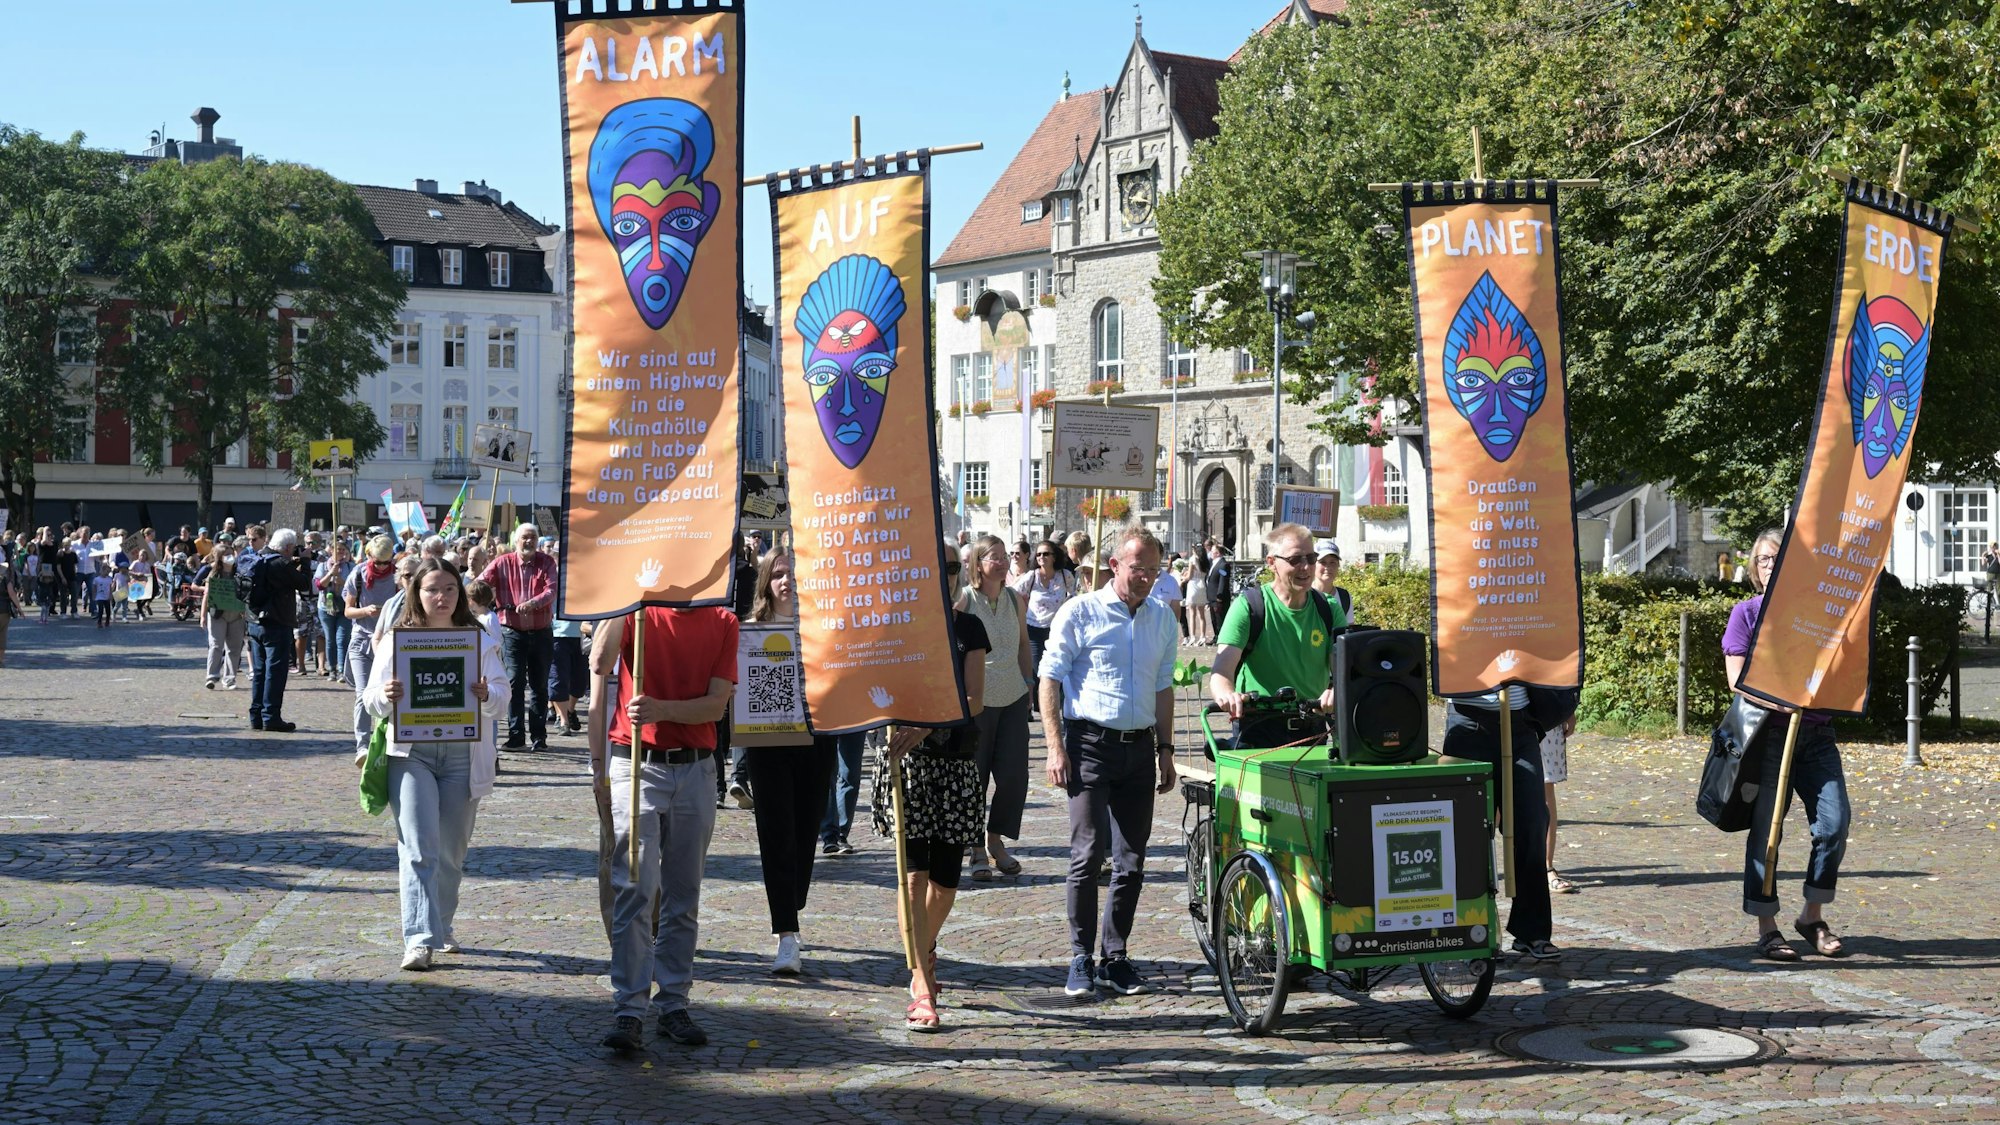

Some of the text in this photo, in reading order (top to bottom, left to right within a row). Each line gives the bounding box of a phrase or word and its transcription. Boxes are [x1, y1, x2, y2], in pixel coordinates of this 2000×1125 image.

[576, 32, 725, 83] ALARM
[809, 195, 892, 253] AUF
[1422, 219, 1543, 258] PLANET
[1865, 224, 1933, 283] ERDE
[598, 348, 716, 368] Wir sind auf
[586, 371, 726, 391] einem Highway
[632, 395, 684, 412] in die
[609, 418, 706, 436] Klimahölle
[609, 440, 706, 458] und haben
[601, 460, 714, 481] den Fuß auf
[587, 484, 723, 503] dem Gaspedal.
[1468, 478, 1536, 494] Draußen
[814, 486, 896, 507] Geschätzt
[1478, 498, 1529, 512] brennt
[1856, 492, 1874, 509] Wir
[803, 510, 876, 528] verlieren
[885, 505, 910, 520] wir
[1470, 515, 1540, 531] die Welt,
[1839, 511, 1882, 532] müssen
[816, 529, 899, 548] 150 Arten
[1472, 537, 1538, 549] da muss
[1842, 530, 1870, 547] nicht
[812, 545, 911, 571] pro Tag und
[1478, 552, 1534, 568] endlich
[803, 566, 930, 590] damit zerstören
[1469, 572, 1546, 589] gehandelt
[1827, 564, 1863, 584] retten,
[815, 588, 919, 610] wir das Netz
[1477, 590, 1539, 605] werden!
[1818, 582, 1862, 601] sondern
[1825, 602, 1847, 617] uns.
[822, 610, 916, 630] des Lebens.
[416, 672, 459, 685] 15.09.
[1411, 815, 1445, 823] HAUSTÜR!
[1393, 849, 1436, 865] 15.09.
[1395, 873, 1431, 884] KLIMA-STREIK
[1380, 937, 1464, 953] christiania bikes
